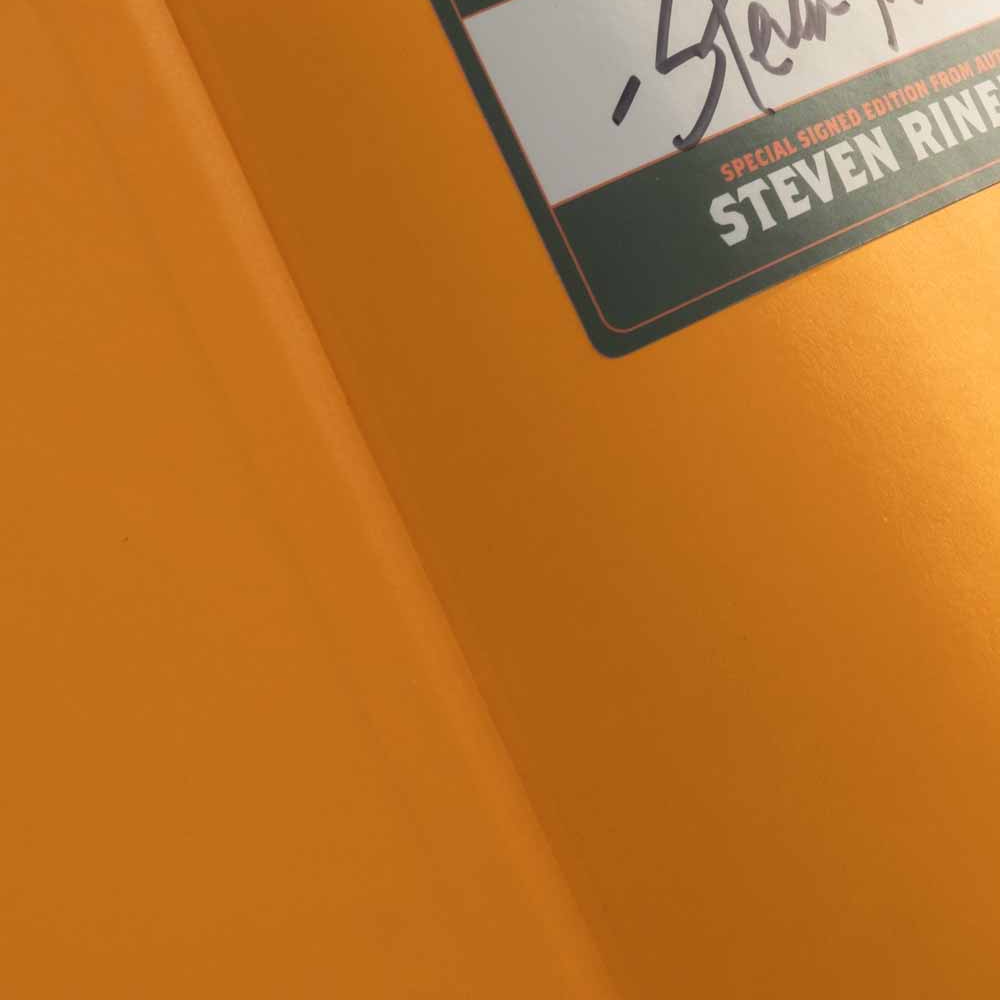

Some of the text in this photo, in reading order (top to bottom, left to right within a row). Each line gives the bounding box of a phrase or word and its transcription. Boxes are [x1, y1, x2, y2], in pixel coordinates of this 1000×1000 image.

[720, 137, 797, 182] SPECIAL
[796, 108, 862, 149] SIGNED
[863, 79, 929, 120] EDITION
[929, 62, 974, 91] FROM
[709, 126, 901, 247] STEVEN
